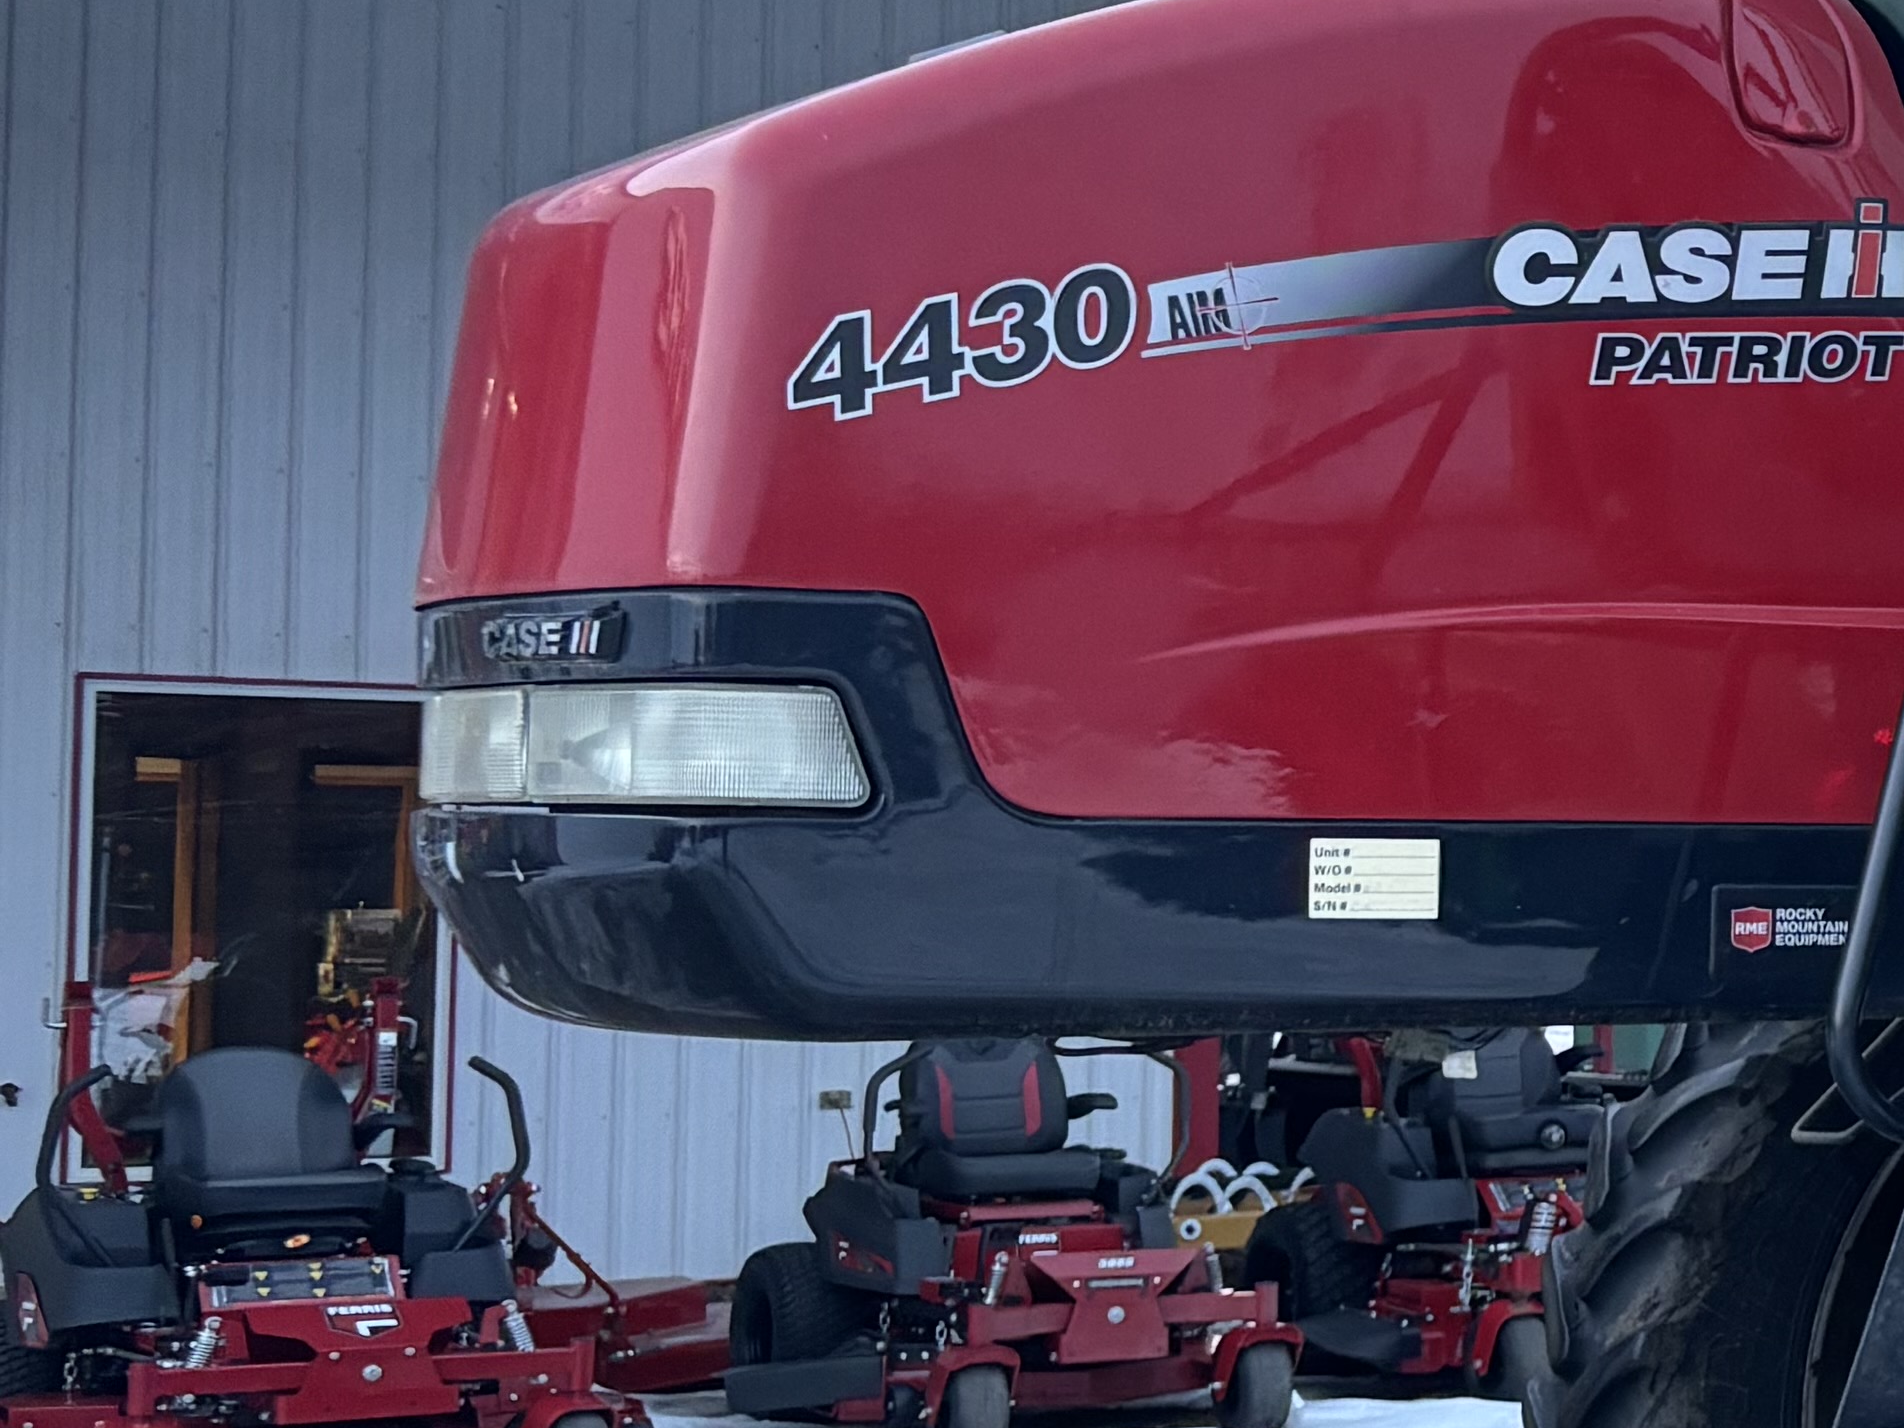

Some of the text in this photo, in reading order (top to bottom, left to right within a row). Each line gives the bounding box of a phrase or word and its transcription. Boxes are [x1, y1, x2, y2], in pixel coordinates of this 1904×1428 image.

[1493, 228, 1811, 307] CASE
[787, 262, 1233, 422] 4430 AIM
[481, 620, 563, 660] CASE
[1314, 847, 1340, 858] Unit
[1313, 883, 1351, 894] Model
[1775, 908, 1825, 921] ROCKY
[1735, 922, 1768, 936] RME
[1775, 921, 1849, 934] MOUNTAIN
[1775, 934, 1848, 947] EQUIPMEN
